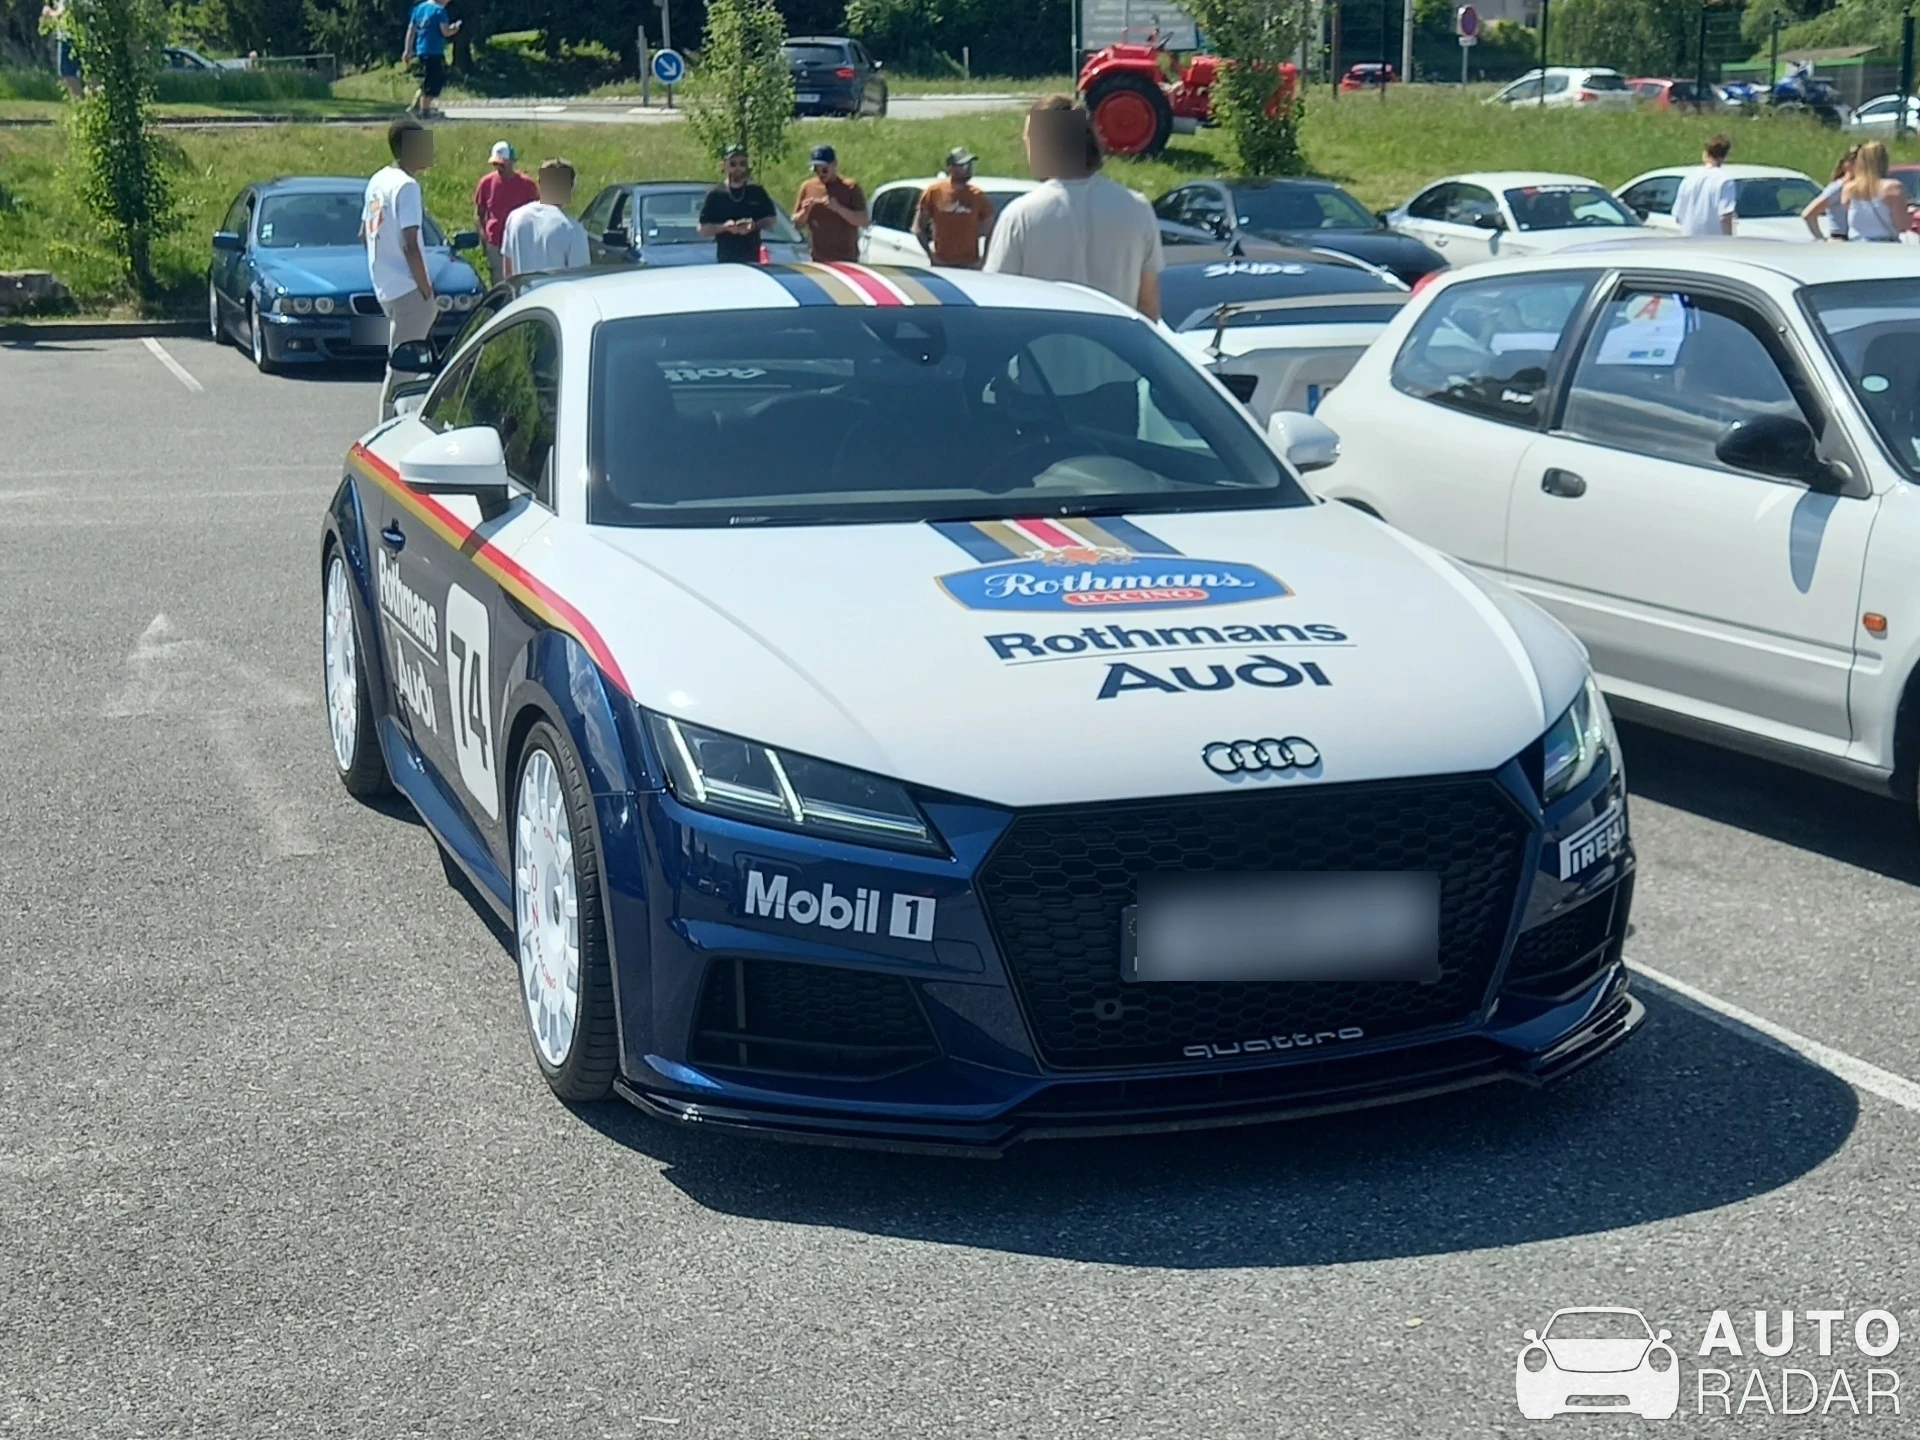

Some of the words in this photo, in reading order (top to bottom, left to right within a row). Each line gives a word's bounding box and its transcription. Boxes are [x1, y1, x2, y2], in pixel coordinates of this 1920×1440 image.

[379, 547, 438, 653] Rothmans
[984, 569, 1256, 600] Rothmans
[1077, 589, 1195, 603] RACING
[984, 621, 1350, 660] Rothmans
[1096, 655, 1333, 700] Audi
[450, 630, 488, 771] 74
[744, 869, 881, 934] Mobil
[1183, 1027, 1365, 1058] quattro
